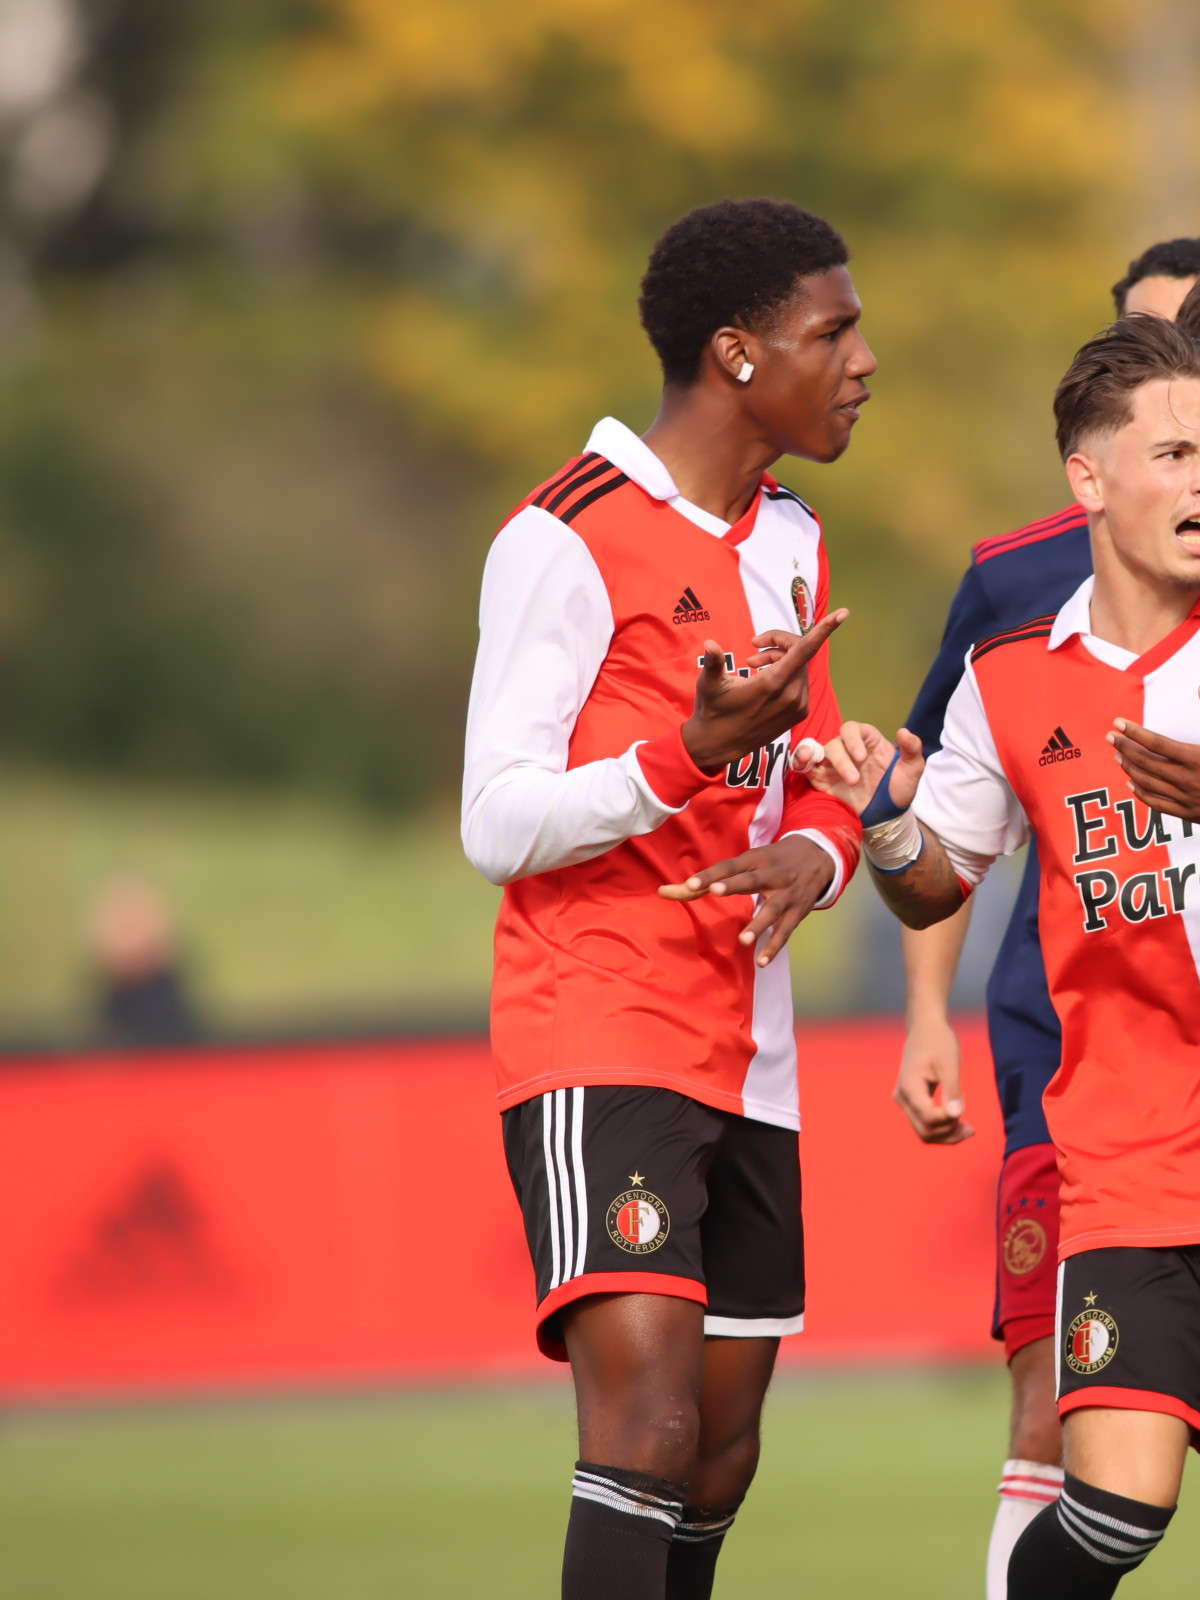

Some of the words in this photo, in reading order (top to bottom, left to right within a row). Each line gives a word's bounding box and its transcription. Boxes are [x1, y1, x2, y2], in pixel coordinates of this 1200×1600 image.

[672, 610, 710, 625] adidas
[1038, 747, 1081, 767] adidas
[611, 1191, 665, 1214] FEYENOORD
[611, 1230, 666, 1252] ROTTERDAM
[1069, 1311, 1114, 1336] FEYENOORD
[1067, 1347, 1114, 1372] ROTTERDAM
